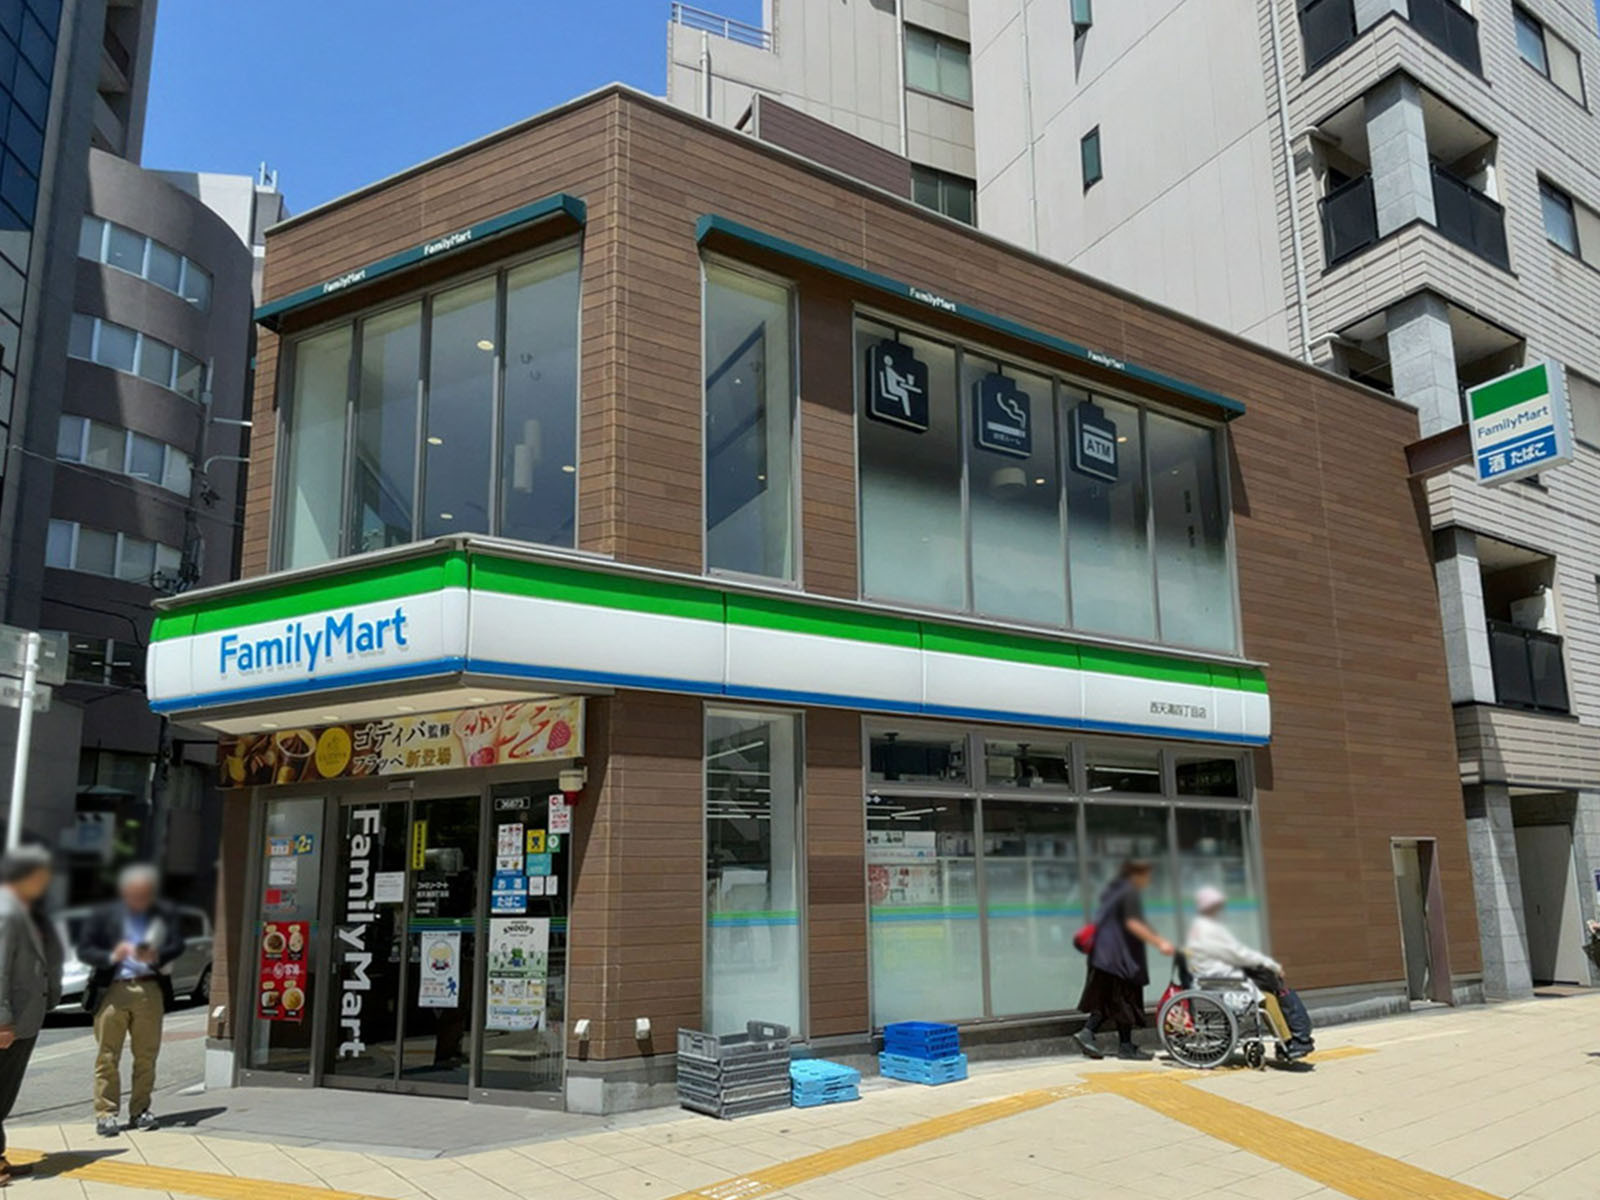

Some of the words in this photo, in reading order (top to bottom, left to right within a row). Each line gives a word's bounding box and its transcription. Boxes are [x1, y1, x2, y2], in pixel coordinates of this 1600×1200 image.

[423, 229, 472, 256] FamilyMart
[322, 269, 366, 294] FamilyMart
[909, 287, 957, 312] FamilyMart
[1087, 350, 1125, 370] FamilyMart
[1477, 406, 1549, 438] FamilyMart
[1086, 437, 1112, 459] ATM
[1511, 442, 1547, 465] たばこ
[220, 607, 407, 673] FamilyMart
[339, 809, 380, 1058] FamilyMart
